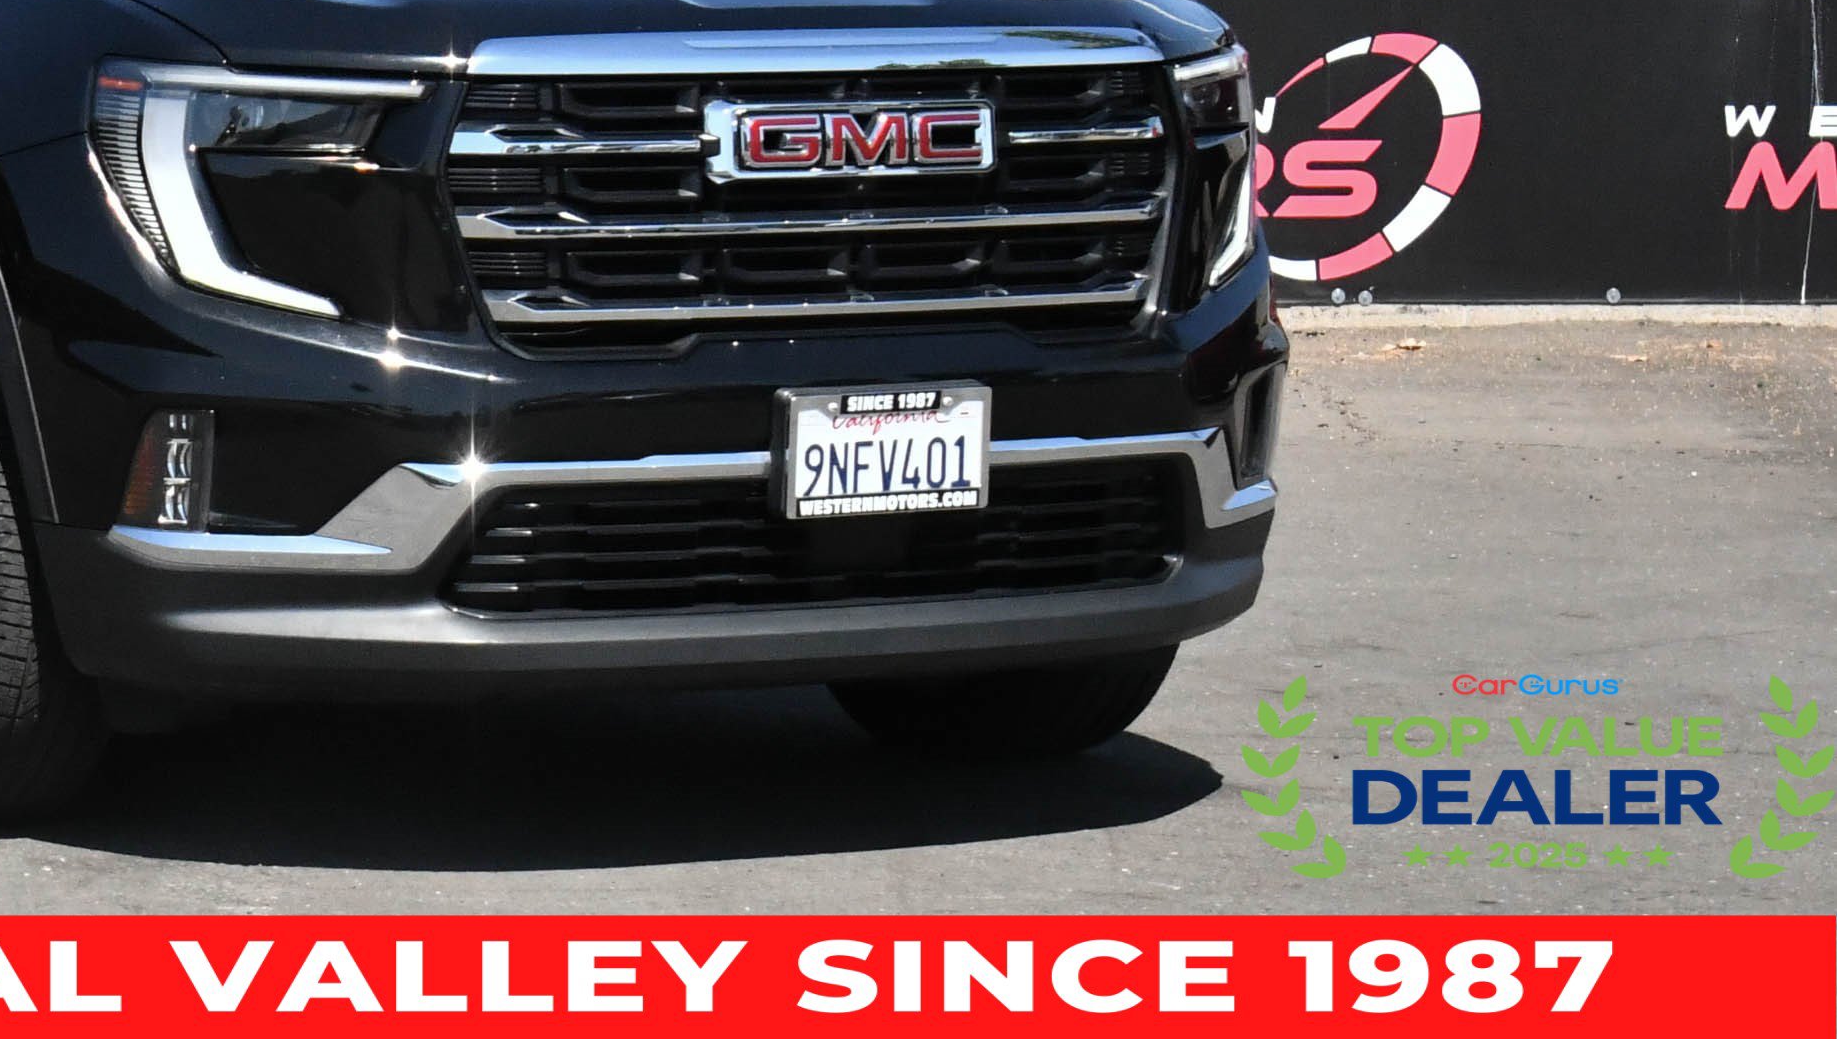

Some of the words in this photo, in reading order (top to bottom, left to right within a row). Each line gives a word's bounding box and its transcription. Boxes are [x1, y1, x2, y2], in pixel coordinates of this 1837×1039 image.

[741, 112, 983, 167] GMC
[847, 395, 894, 412] SINCE
[897, 392, 937, 410] 1987
[803, 435, 971, 496] 9NFV401
[798, 490, 978, 516] WESTERNMOTORS.COM
